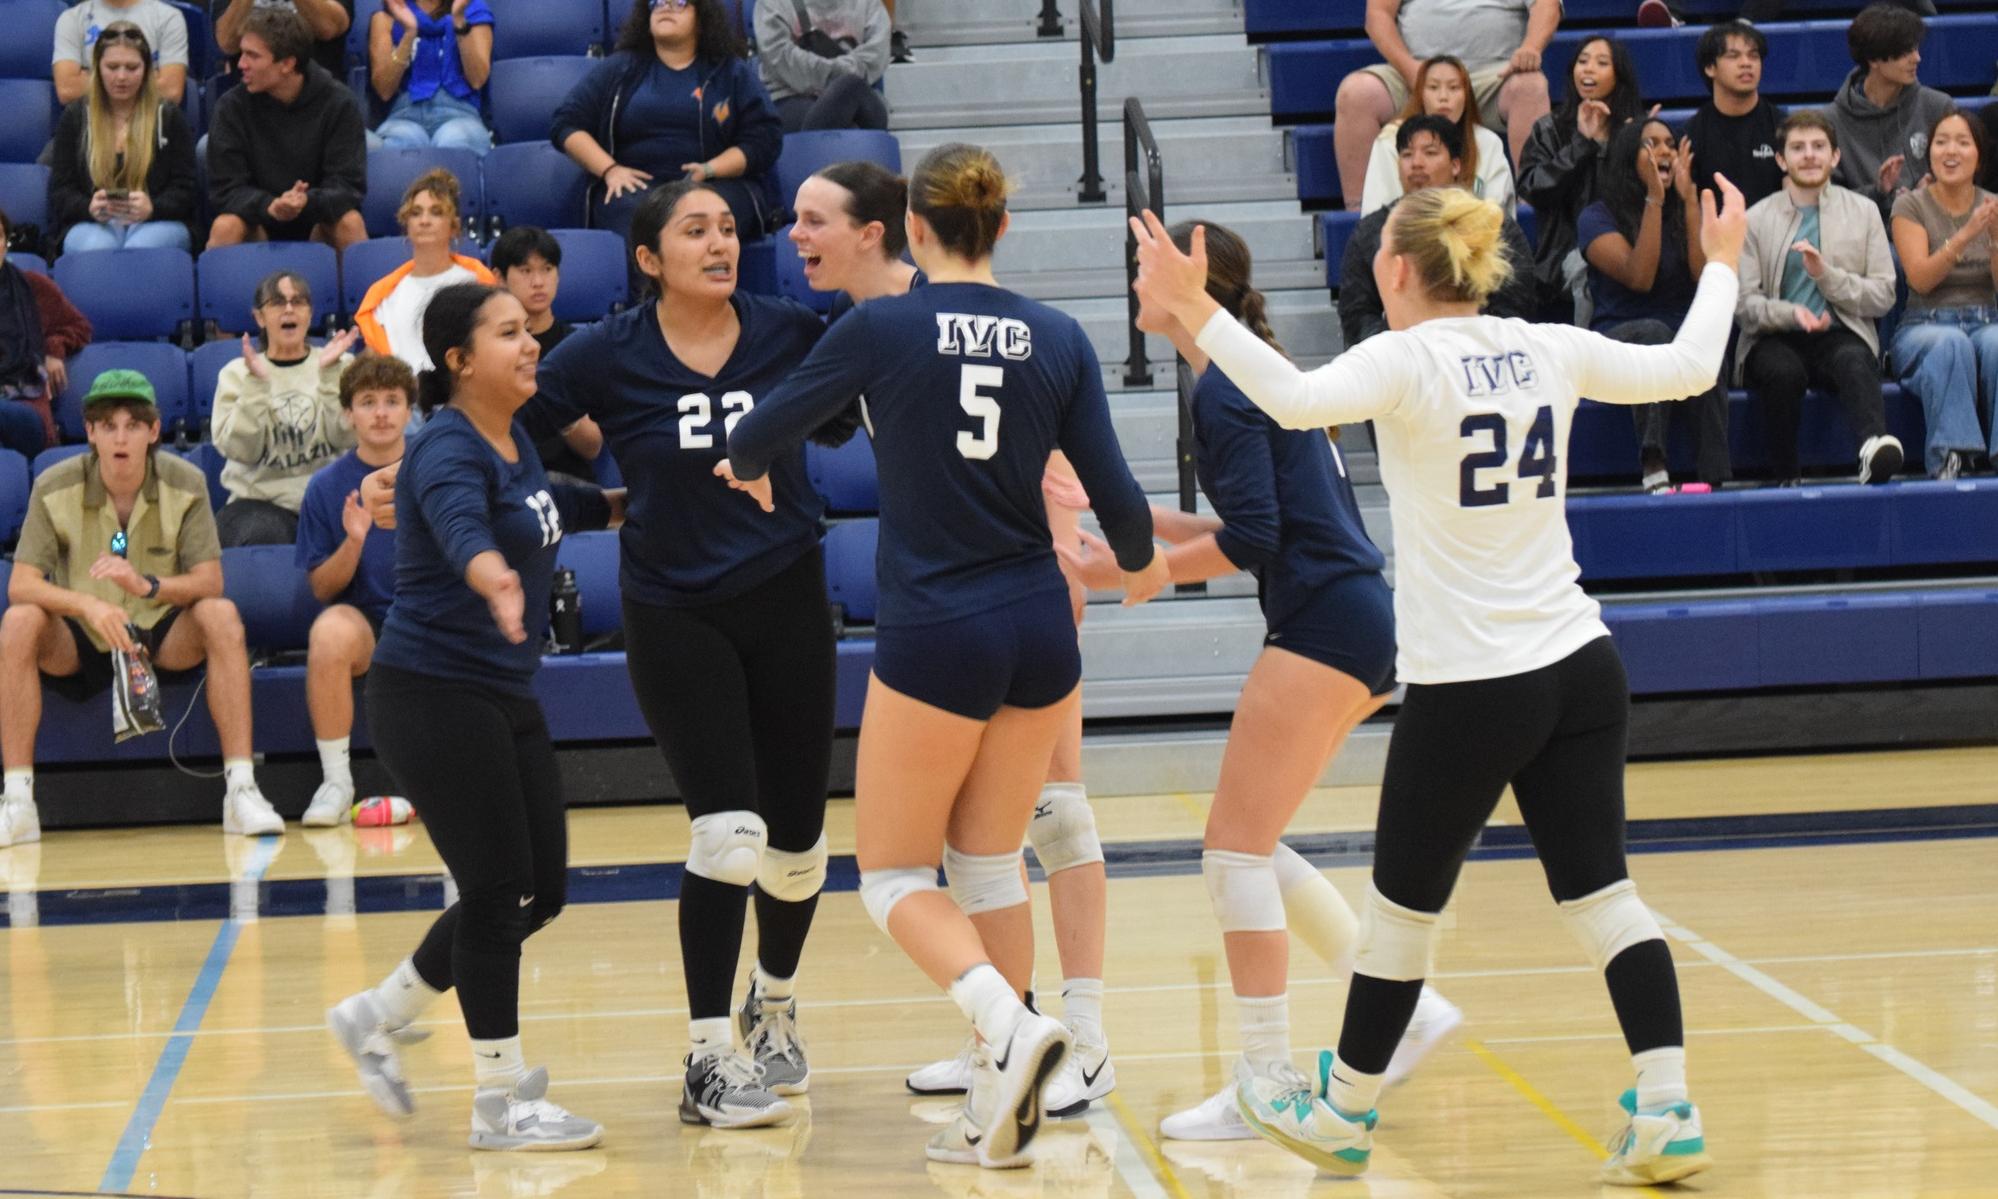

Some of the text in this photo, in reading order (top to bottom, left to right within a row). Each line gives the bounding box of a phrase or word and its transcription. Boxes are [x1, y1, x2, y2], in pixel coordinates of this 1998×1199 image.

[936, 312, 1032, 361] IVC
[1460, 352, 1538, 397] IVC
[956, 363, 1004, 460] 5
[1460, 405, 1556, 507] 24
